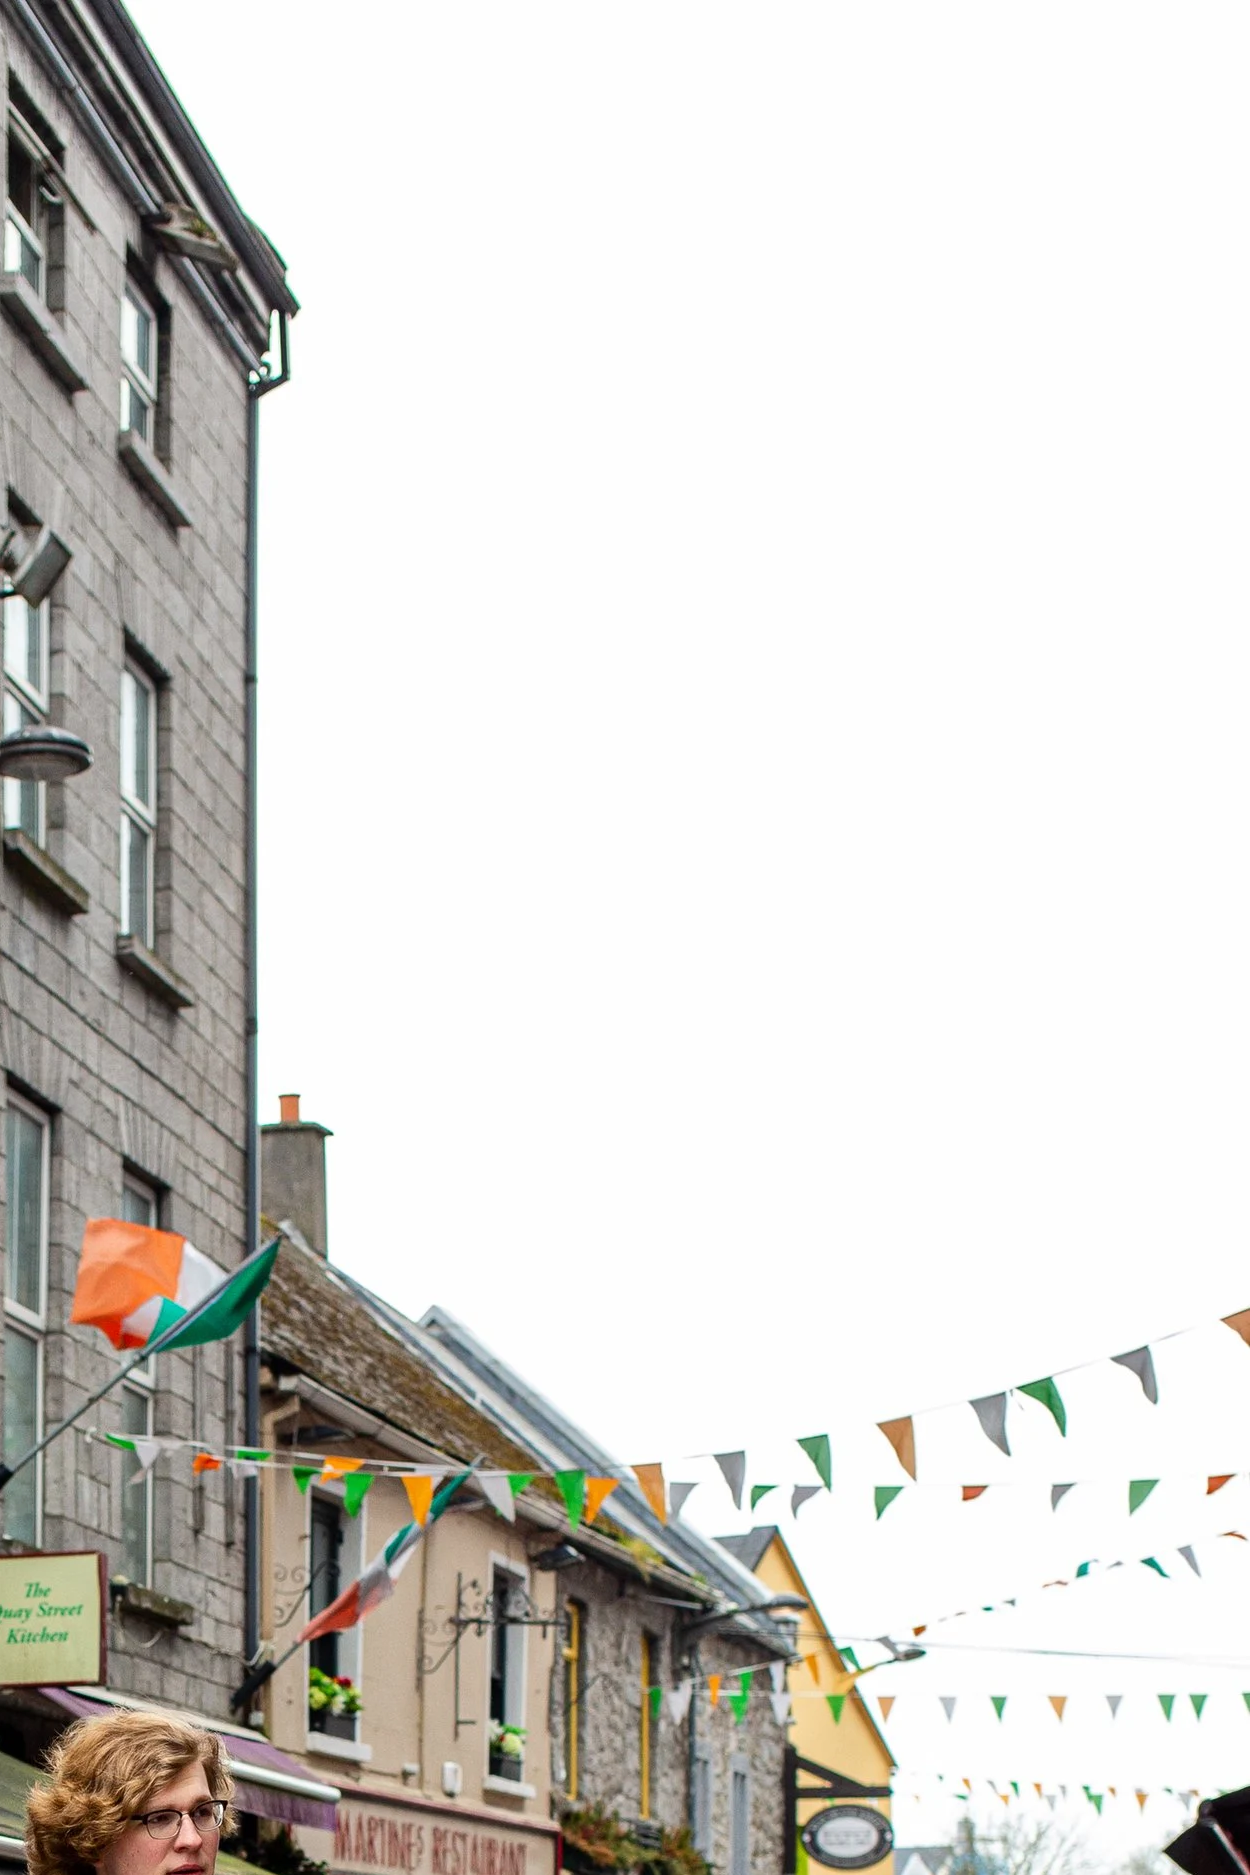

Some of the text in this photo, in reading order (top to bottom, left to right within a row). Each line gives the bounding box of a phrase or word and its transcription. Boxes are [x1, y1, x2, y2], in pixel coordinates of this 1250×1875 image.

[25, 1581, 52, 1598] The
[36, 1602, 84, 1618] Street
[6, 1626, 69, 1645] Kitchen
